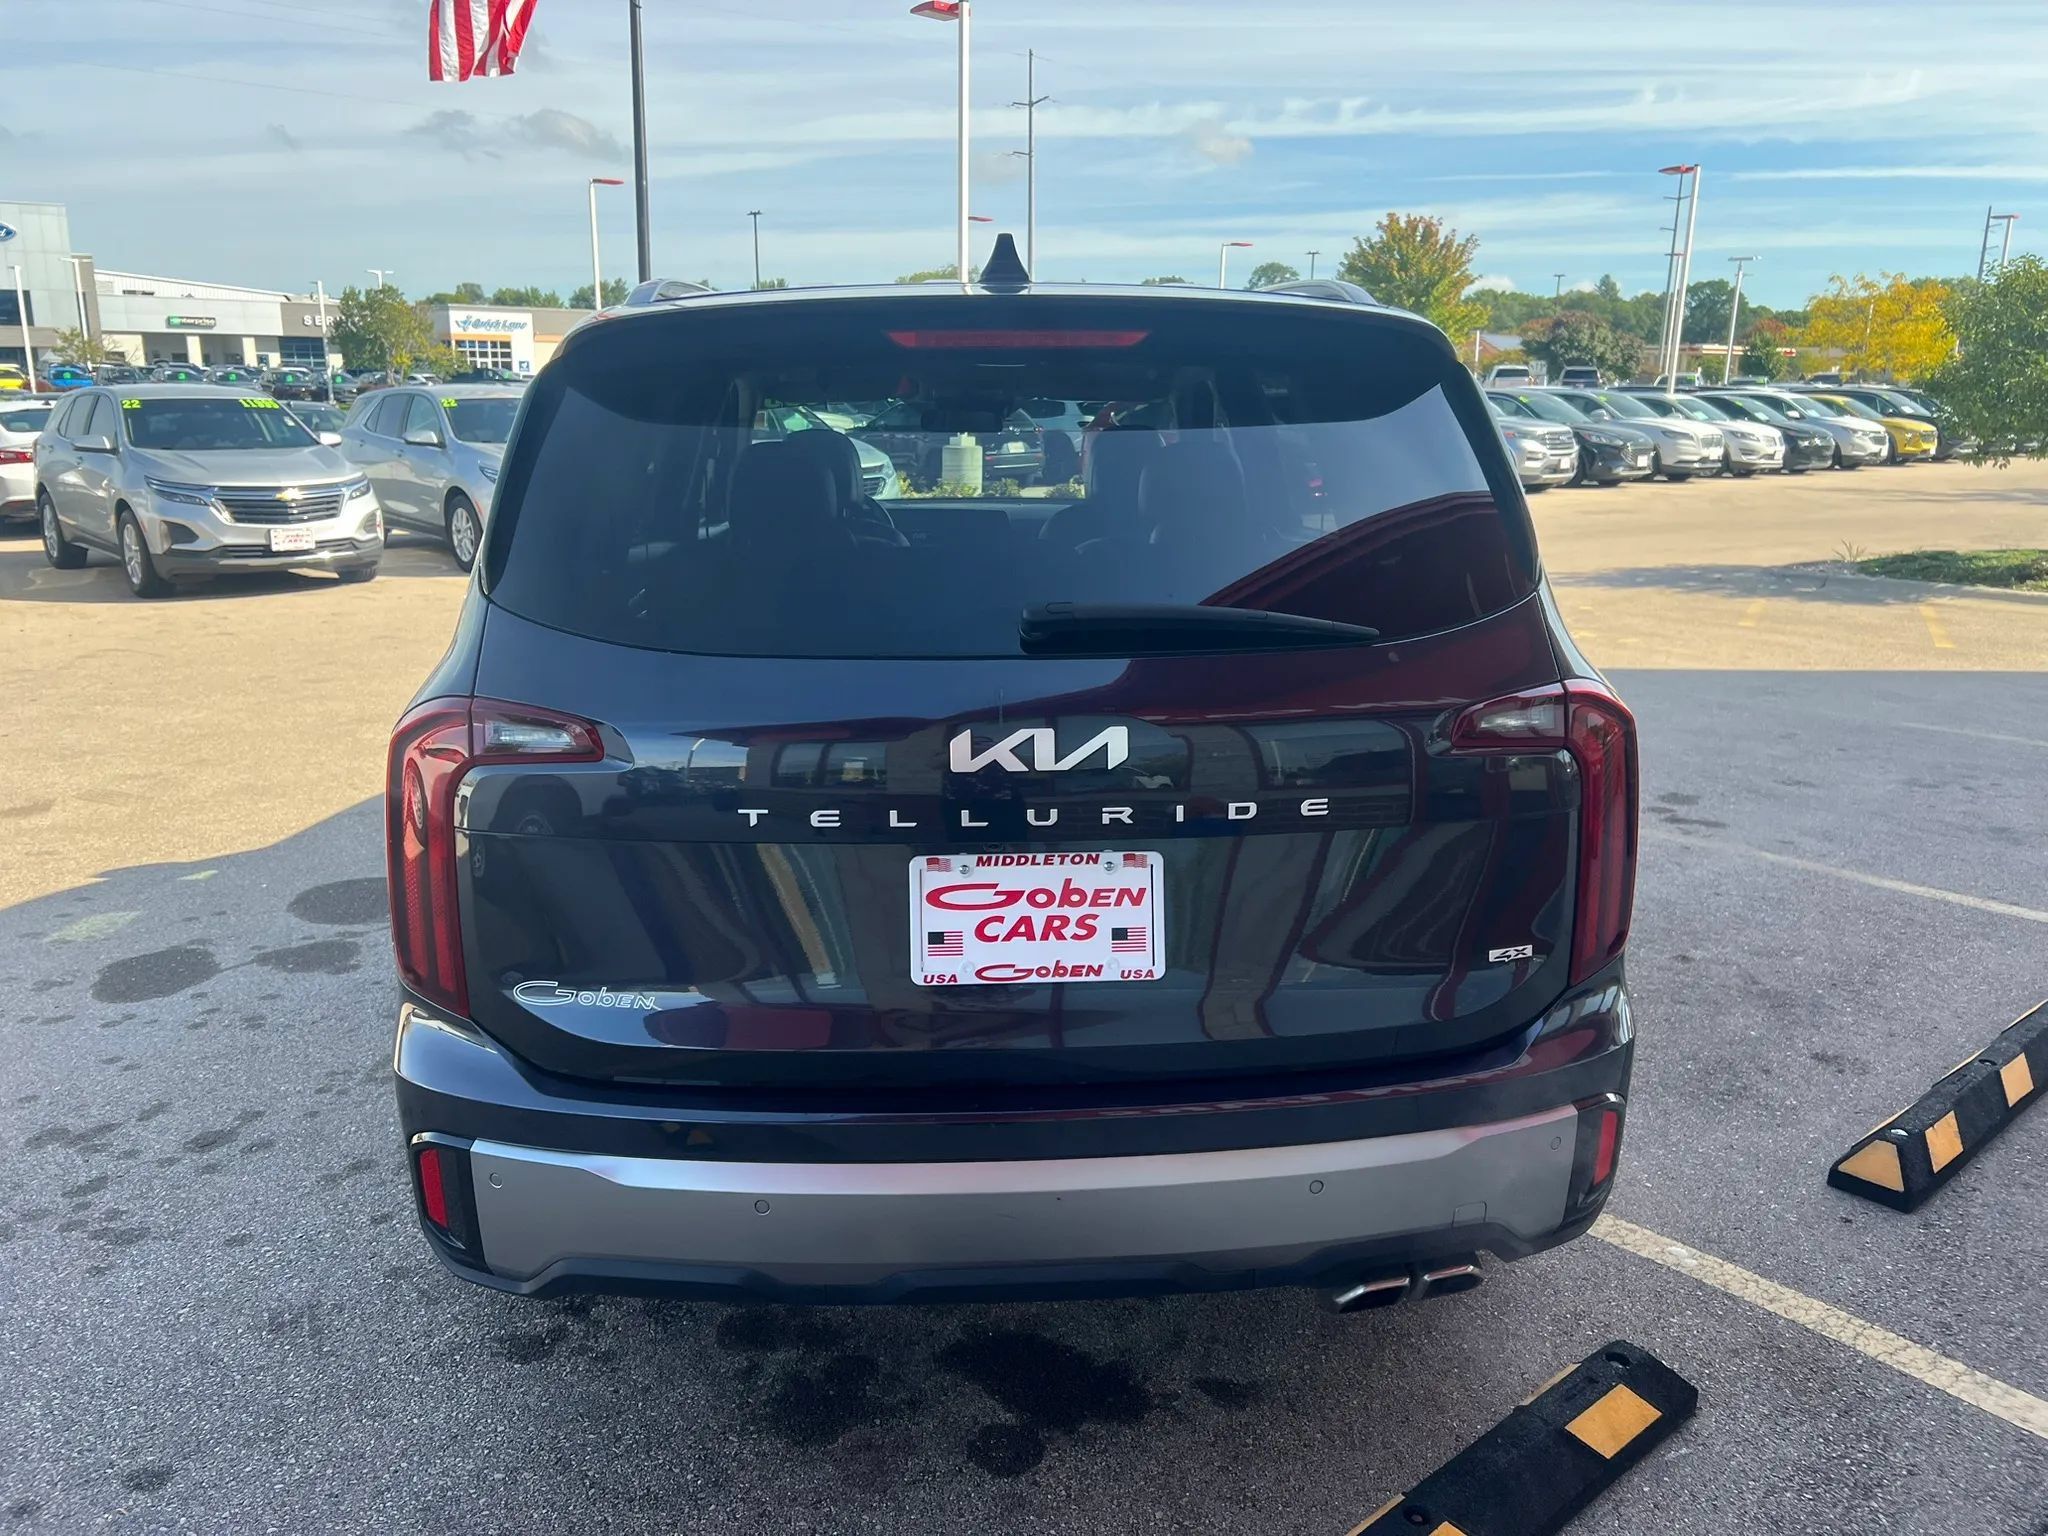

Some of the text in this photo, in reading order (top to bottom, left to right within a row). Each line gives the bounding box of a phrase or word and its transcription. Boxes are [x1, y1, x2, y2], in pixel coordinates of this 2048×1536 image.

[122, 400, 141, 409] 22
[441, 399, 458, 408] 22
[949, 726, 1128, 773] KIA
[738, 798, 1330, 829] TELLURIDE
[976, 854, 1099, 867] MIDDLETON
[974, 914, 1099, 943] CARS
[923, 974, 958, 984] USA
[1120, 969, 1155, 979] USA
